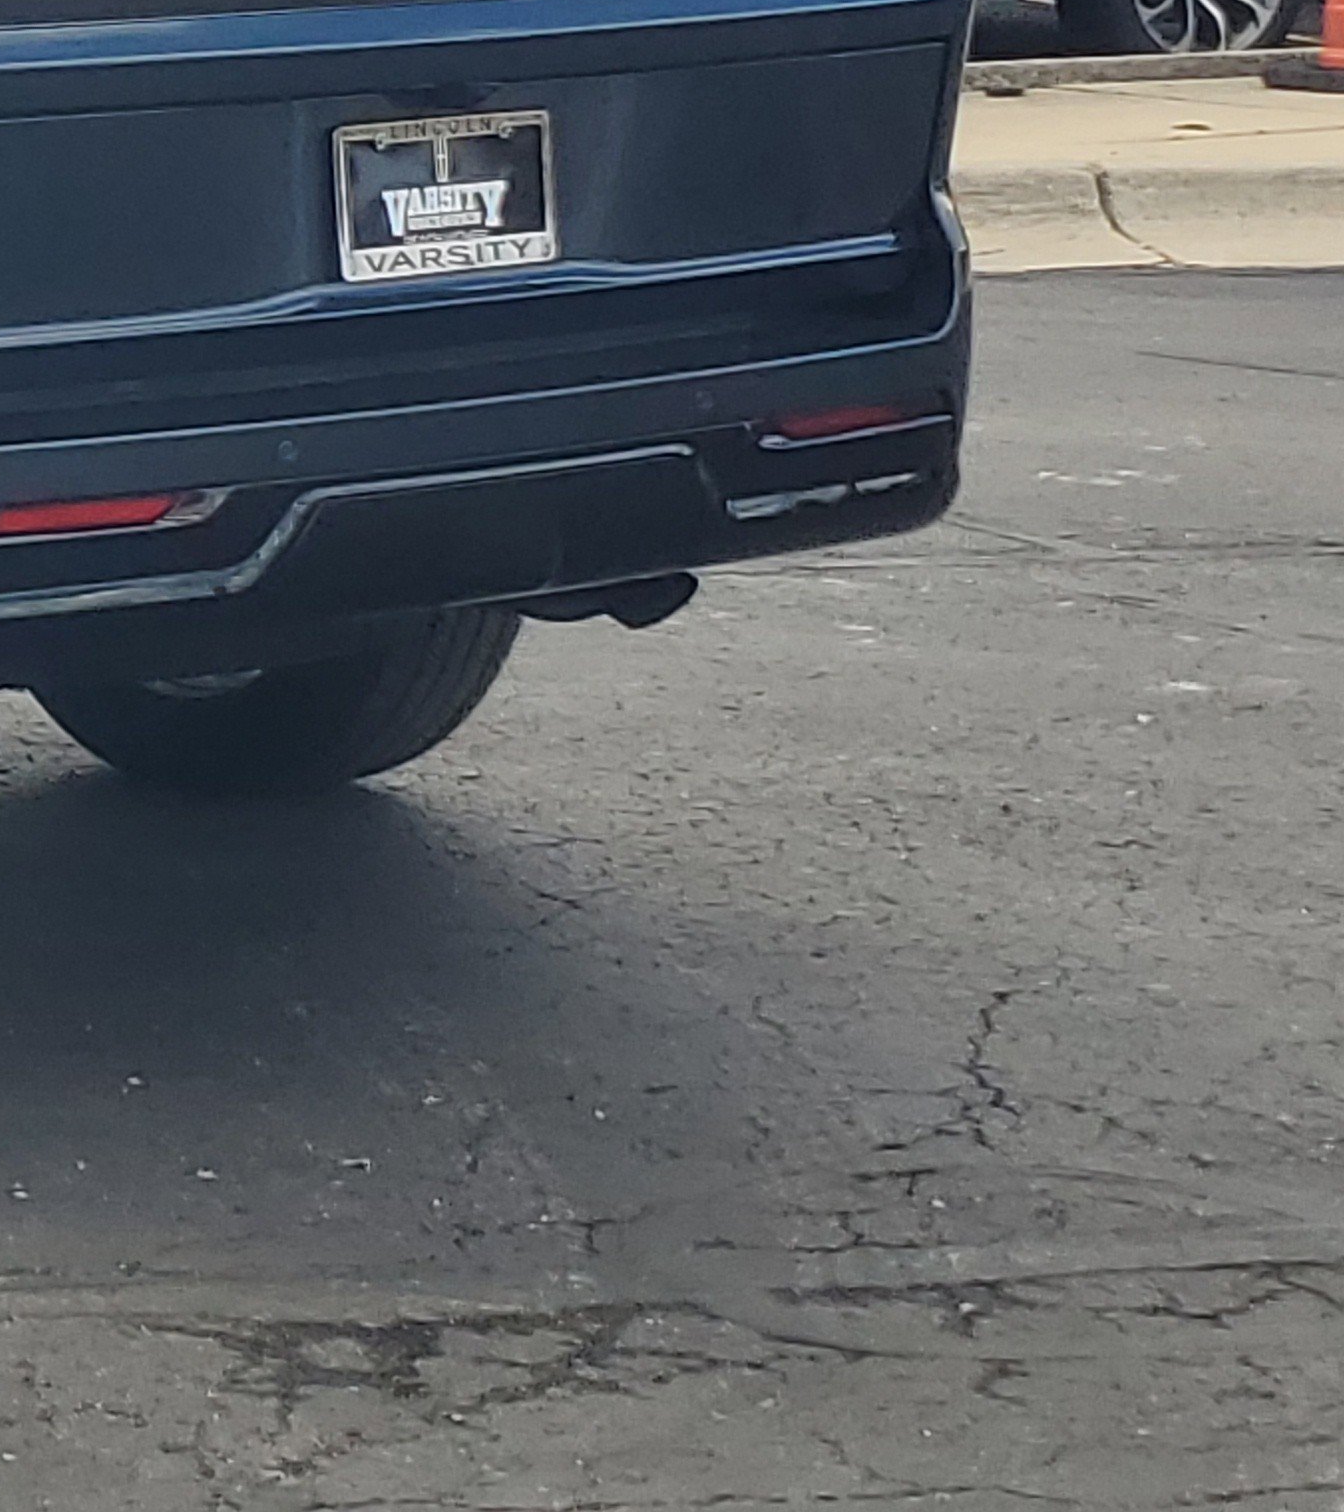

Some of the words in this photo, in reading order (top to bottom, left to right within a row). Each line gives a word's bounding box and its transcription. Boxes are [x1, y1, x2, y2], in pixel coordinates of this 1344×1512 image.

[389, 118, 492, 139] LINCOLN
[381, 180, 509, 237] VARSITY
[365, 238, 531, 273] VARSITY
